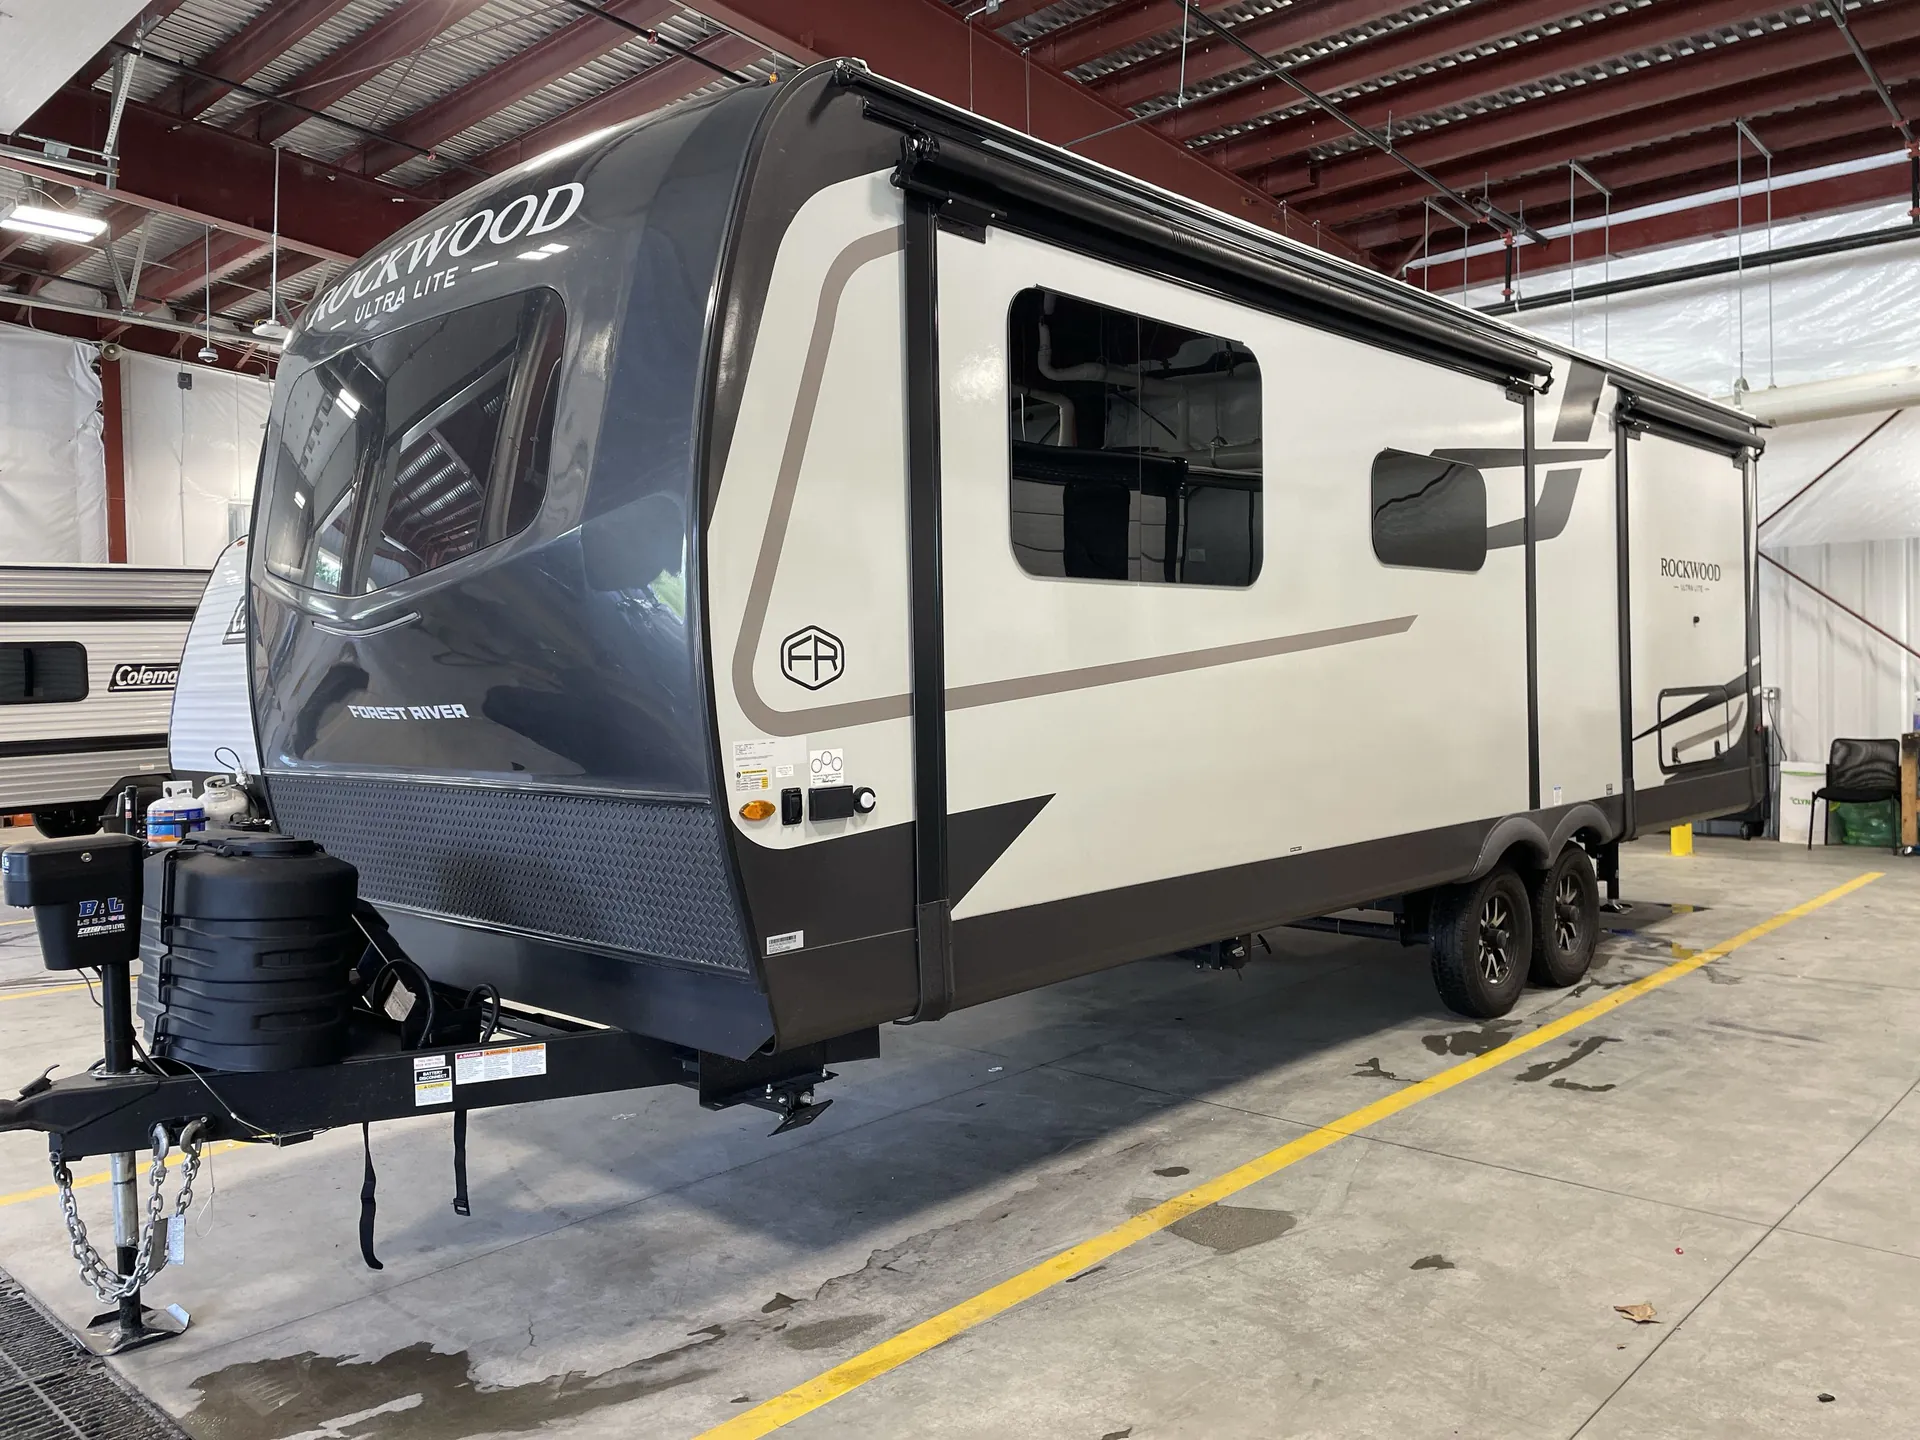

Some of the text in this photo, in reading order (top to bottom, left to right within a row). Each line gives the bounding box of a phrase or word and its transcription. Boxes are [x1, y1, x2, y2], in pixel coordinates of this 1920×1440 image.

[305, 183, 584, 331] ROCKWOOD
[354, 266, 459, 323] ULTRA LITE
[1660, 557, 1721, 581] ROCKWOOD
[115, 666, 178, 686] Colema
[347, 704, 470, 720] FOREST RIVER
